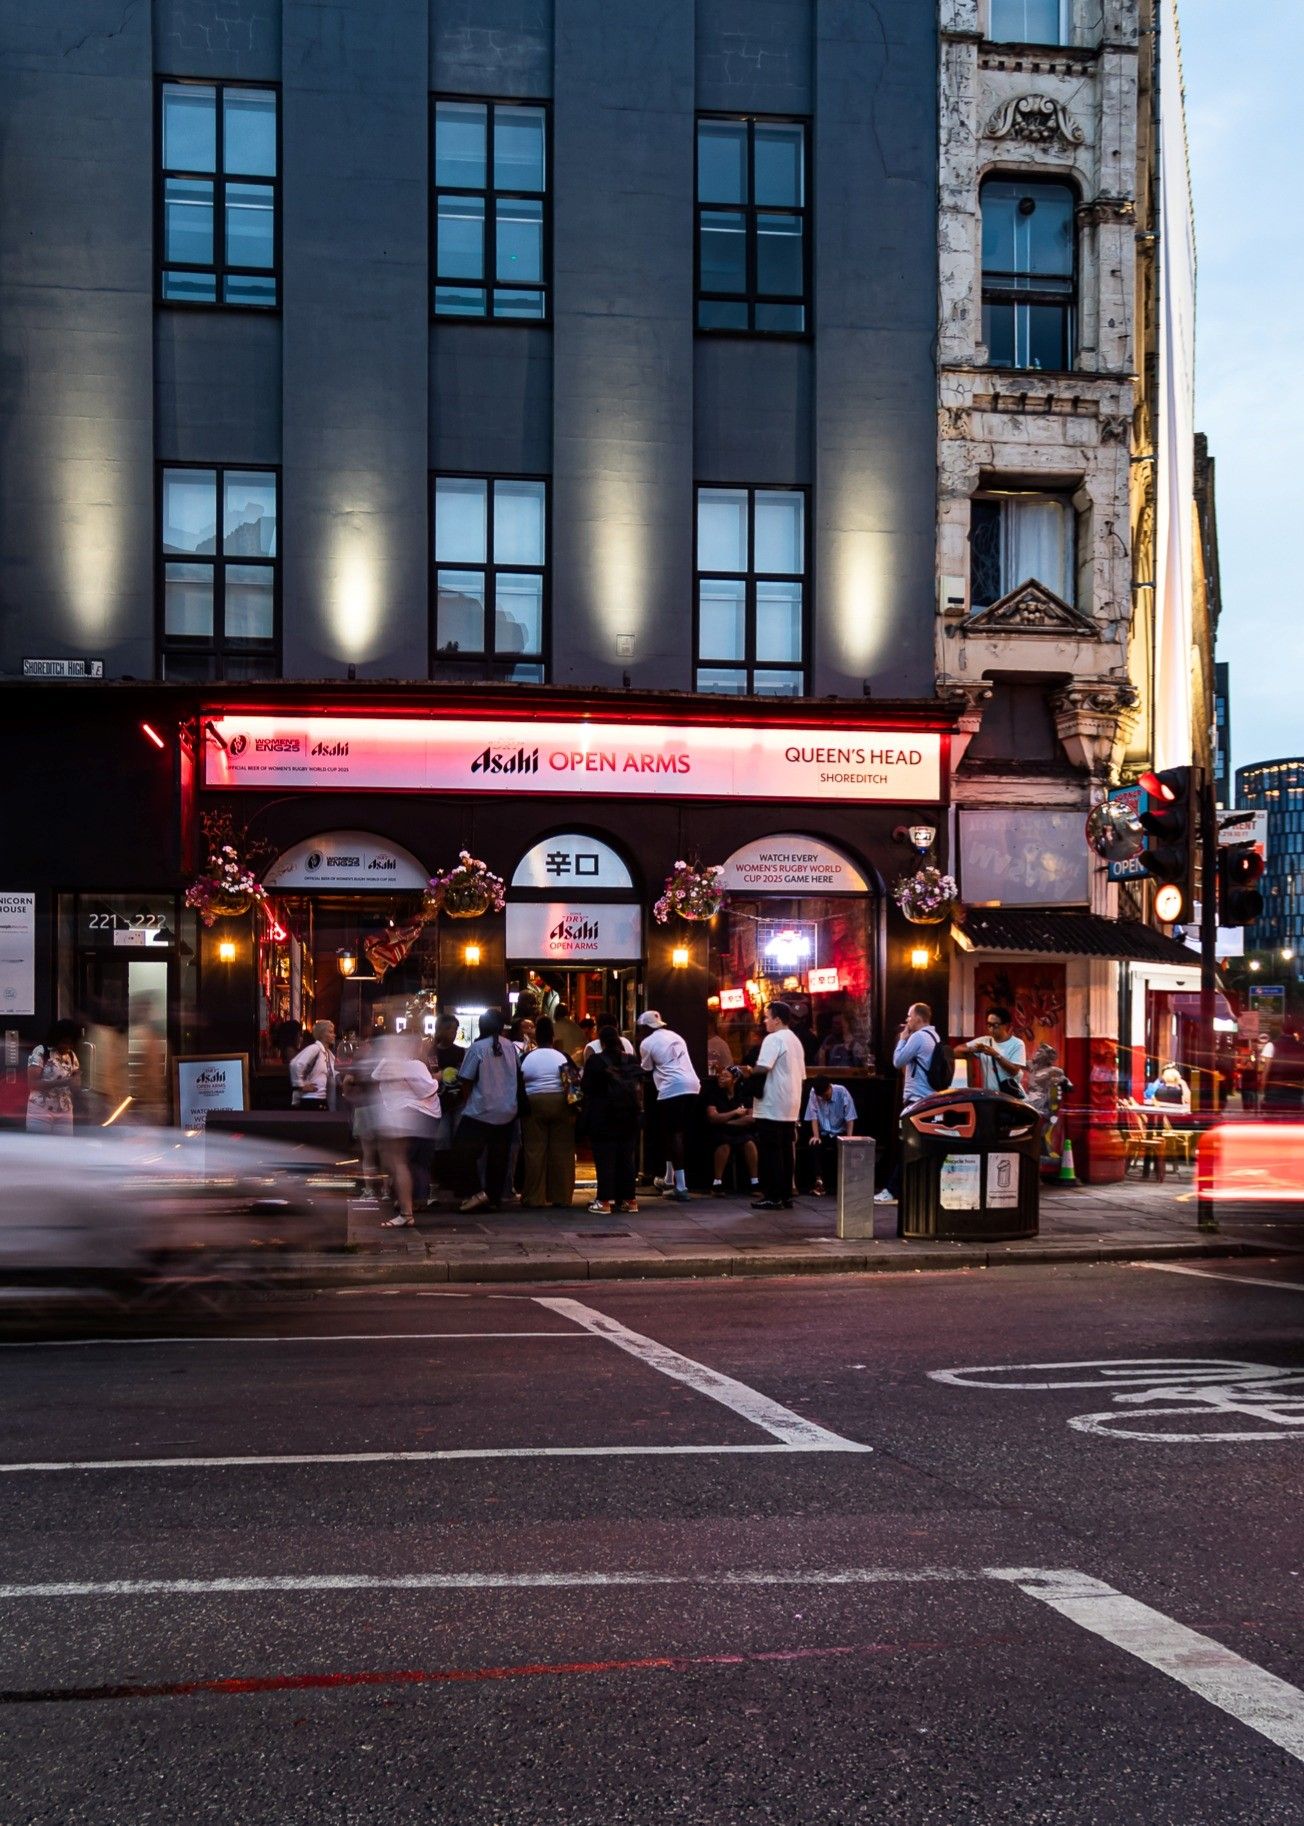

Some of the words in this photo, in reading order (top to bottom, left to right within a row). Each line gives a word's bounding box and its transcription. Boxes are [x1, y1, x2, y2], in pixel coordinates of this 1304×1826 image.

[67, 661, 84, 675] HIGH
[311, 742, 349, 756] Asahi
[785, 747, 865, 764] QUEEN'S
[870, 749, 922, 765] HEAD
[470, 746, 539, 774] Asahi
[549, 751, 616, 772] OPEN
[622, 753, 691, 774] ARMS
[820, 772, 888, 784] SHOREDITCH
[368, 859, 397, 870] Asahi
[545, 851, 599, 876] 辛口
[759, 854, 790, 862] WATCH
[791, 854, 819, 862] EVERY
[735, 864, 778, 872] WOMEN'S
[779, 864, 808, 873] RUGBY
[809, 865, 842, 873] WORLD
[1112, 857, 1144, 875] OPEN
[743, 874, 762, 883] CUP
[763, 875, 783, 883] 2025
[784, 875, 810, 883] GAME
[811, 875, 834, 883] HERE
[89, 913, 117, 929] 221
[135, 914, 167, 929] 222
[550, 920, 599, 940] Asahi
[550, 942, 573, 950] OPEN
[574, 942, 598, 950] ARMS
[196, 1071, 226, 1083] Asahi
